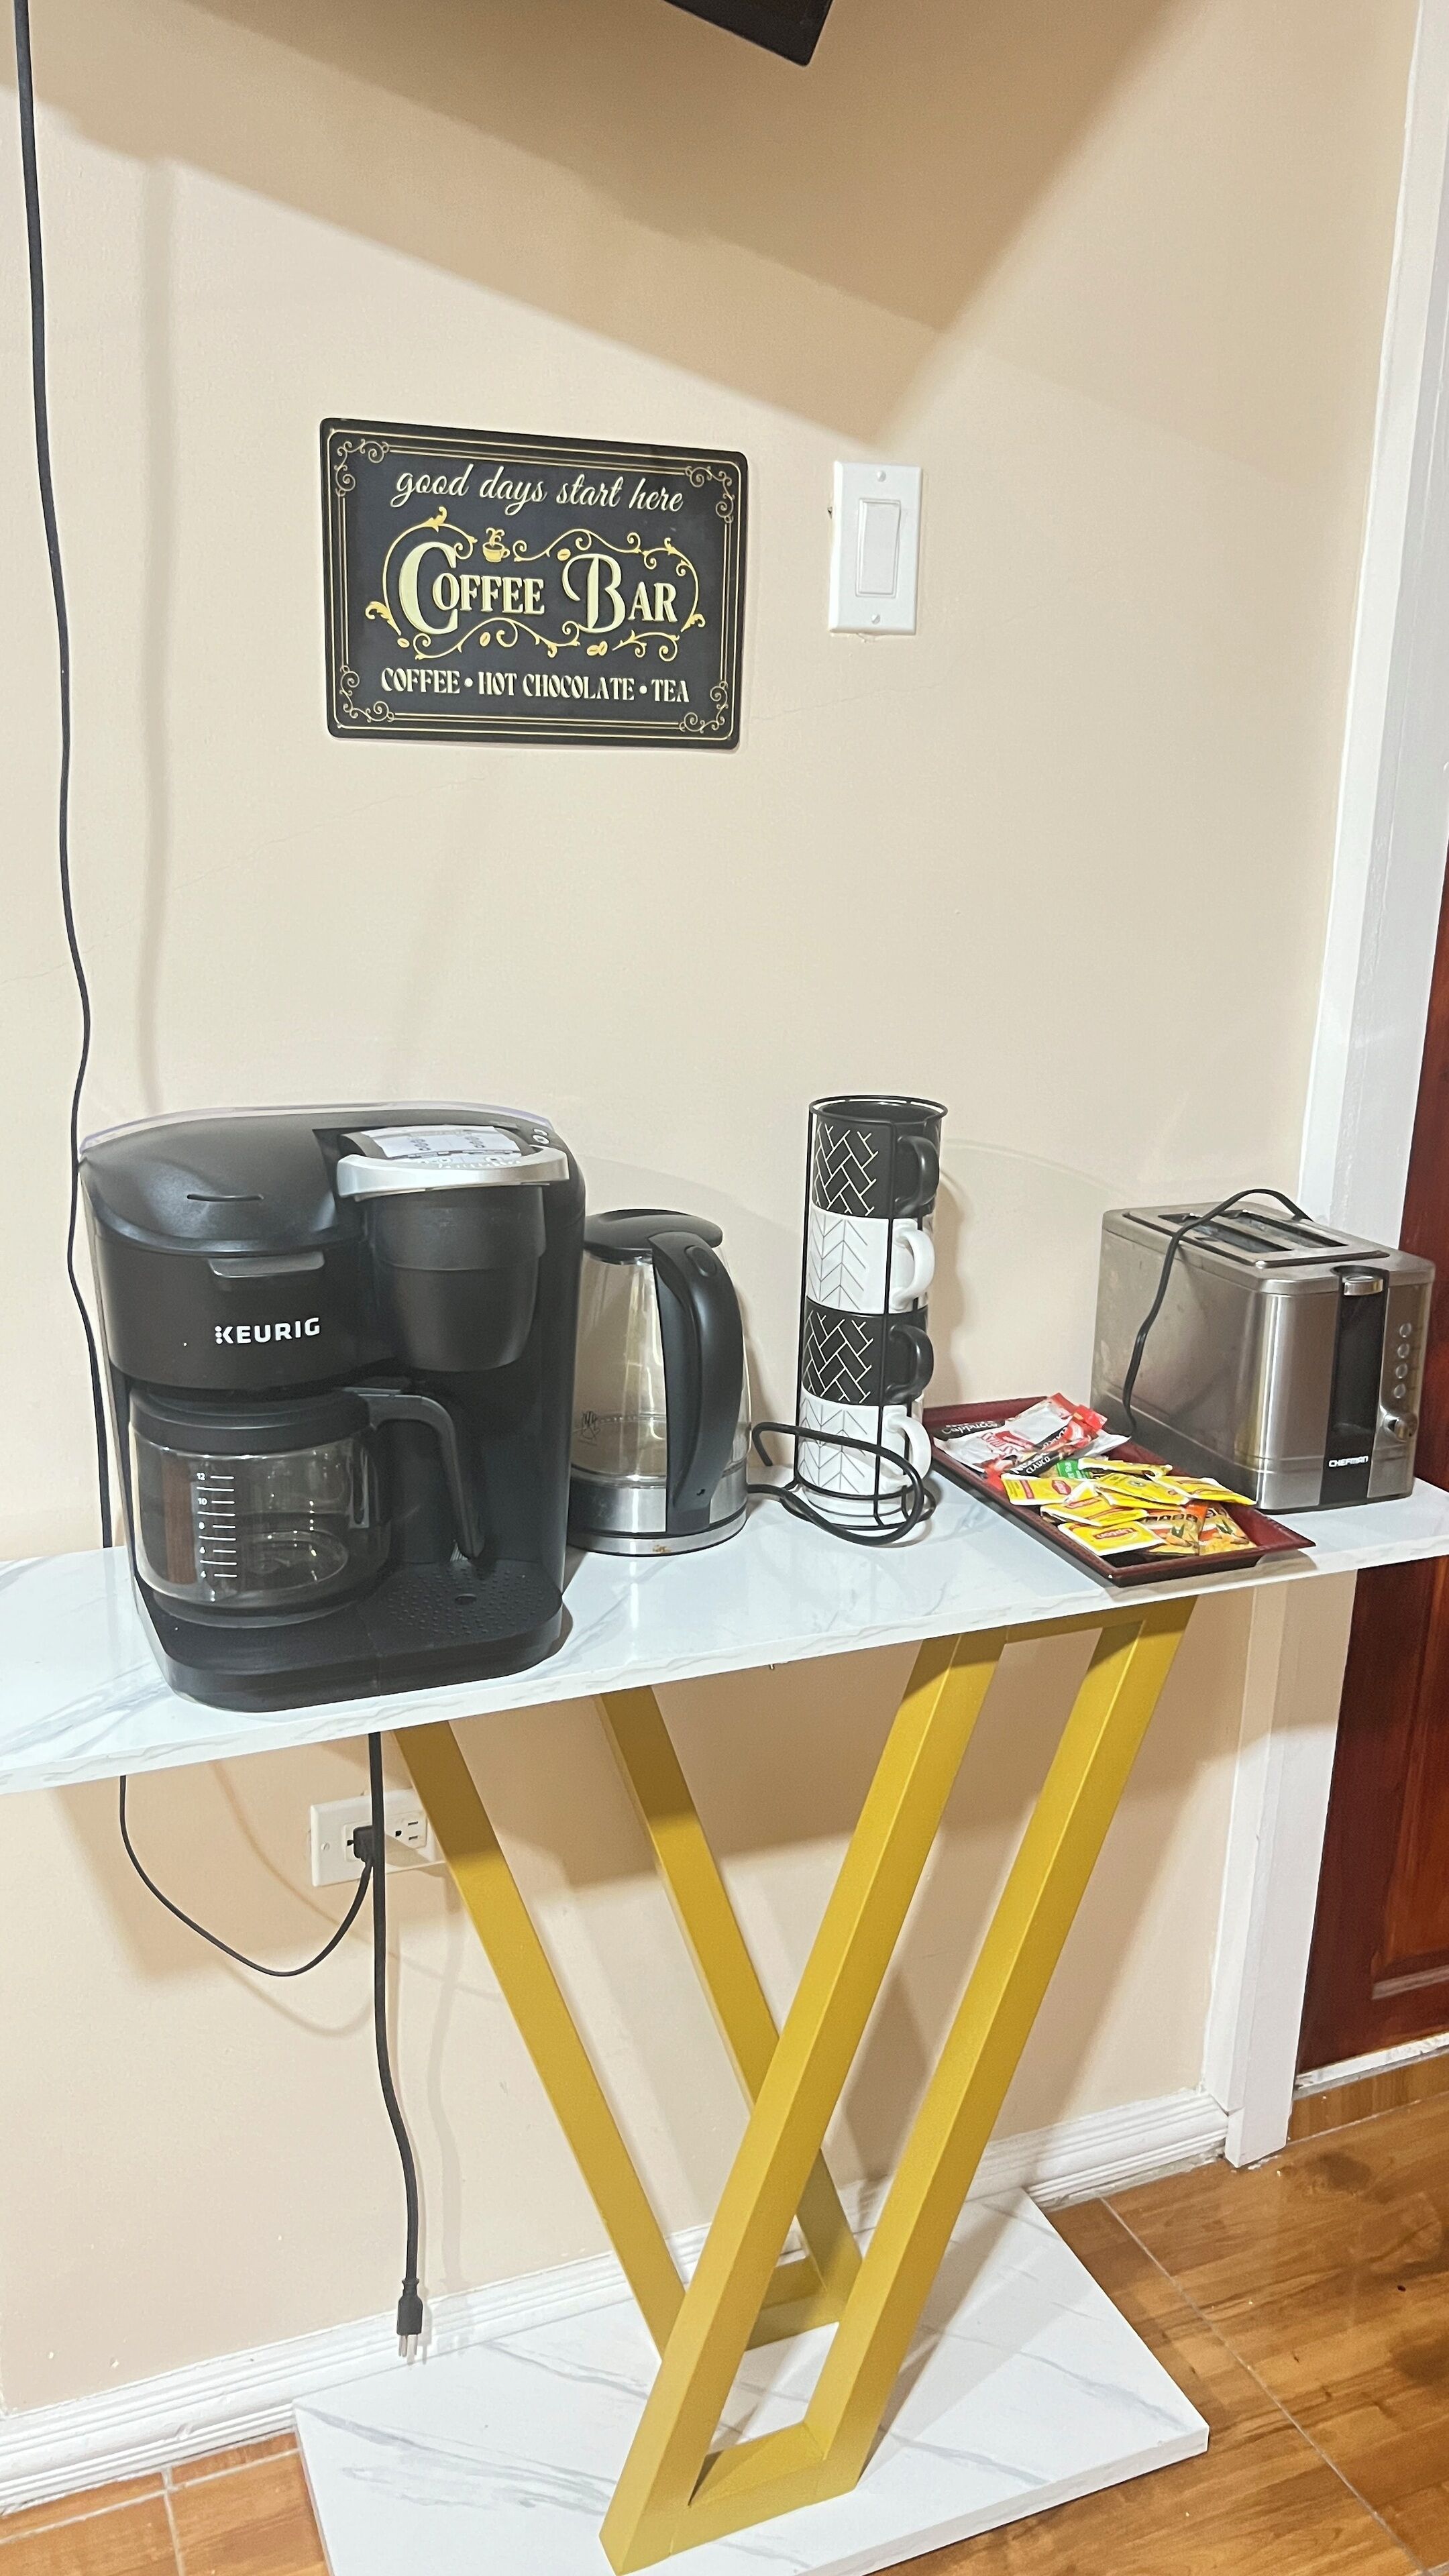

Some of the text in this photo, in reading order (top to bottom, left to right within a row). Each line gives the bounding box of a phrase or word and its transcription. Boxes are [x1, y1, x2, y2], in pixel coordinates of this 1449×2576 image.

[390, 464, 684, 517] good days start here
[380, 667, 690, 703] COFFEE HOT CHOCOLATE TEA
[215, 1317, 320, 1344] KEURIG
[1328, 1455, 1368, 1467] CHEFMAN
[197, 1472, 206, 1481] 12
[197, 1497, 208, 1505] 10
[199, 1521, 205, 1529] 8
[1097, 1528, 1134, 1540] Lipton
[201, 1570, 207, 1578] 4
